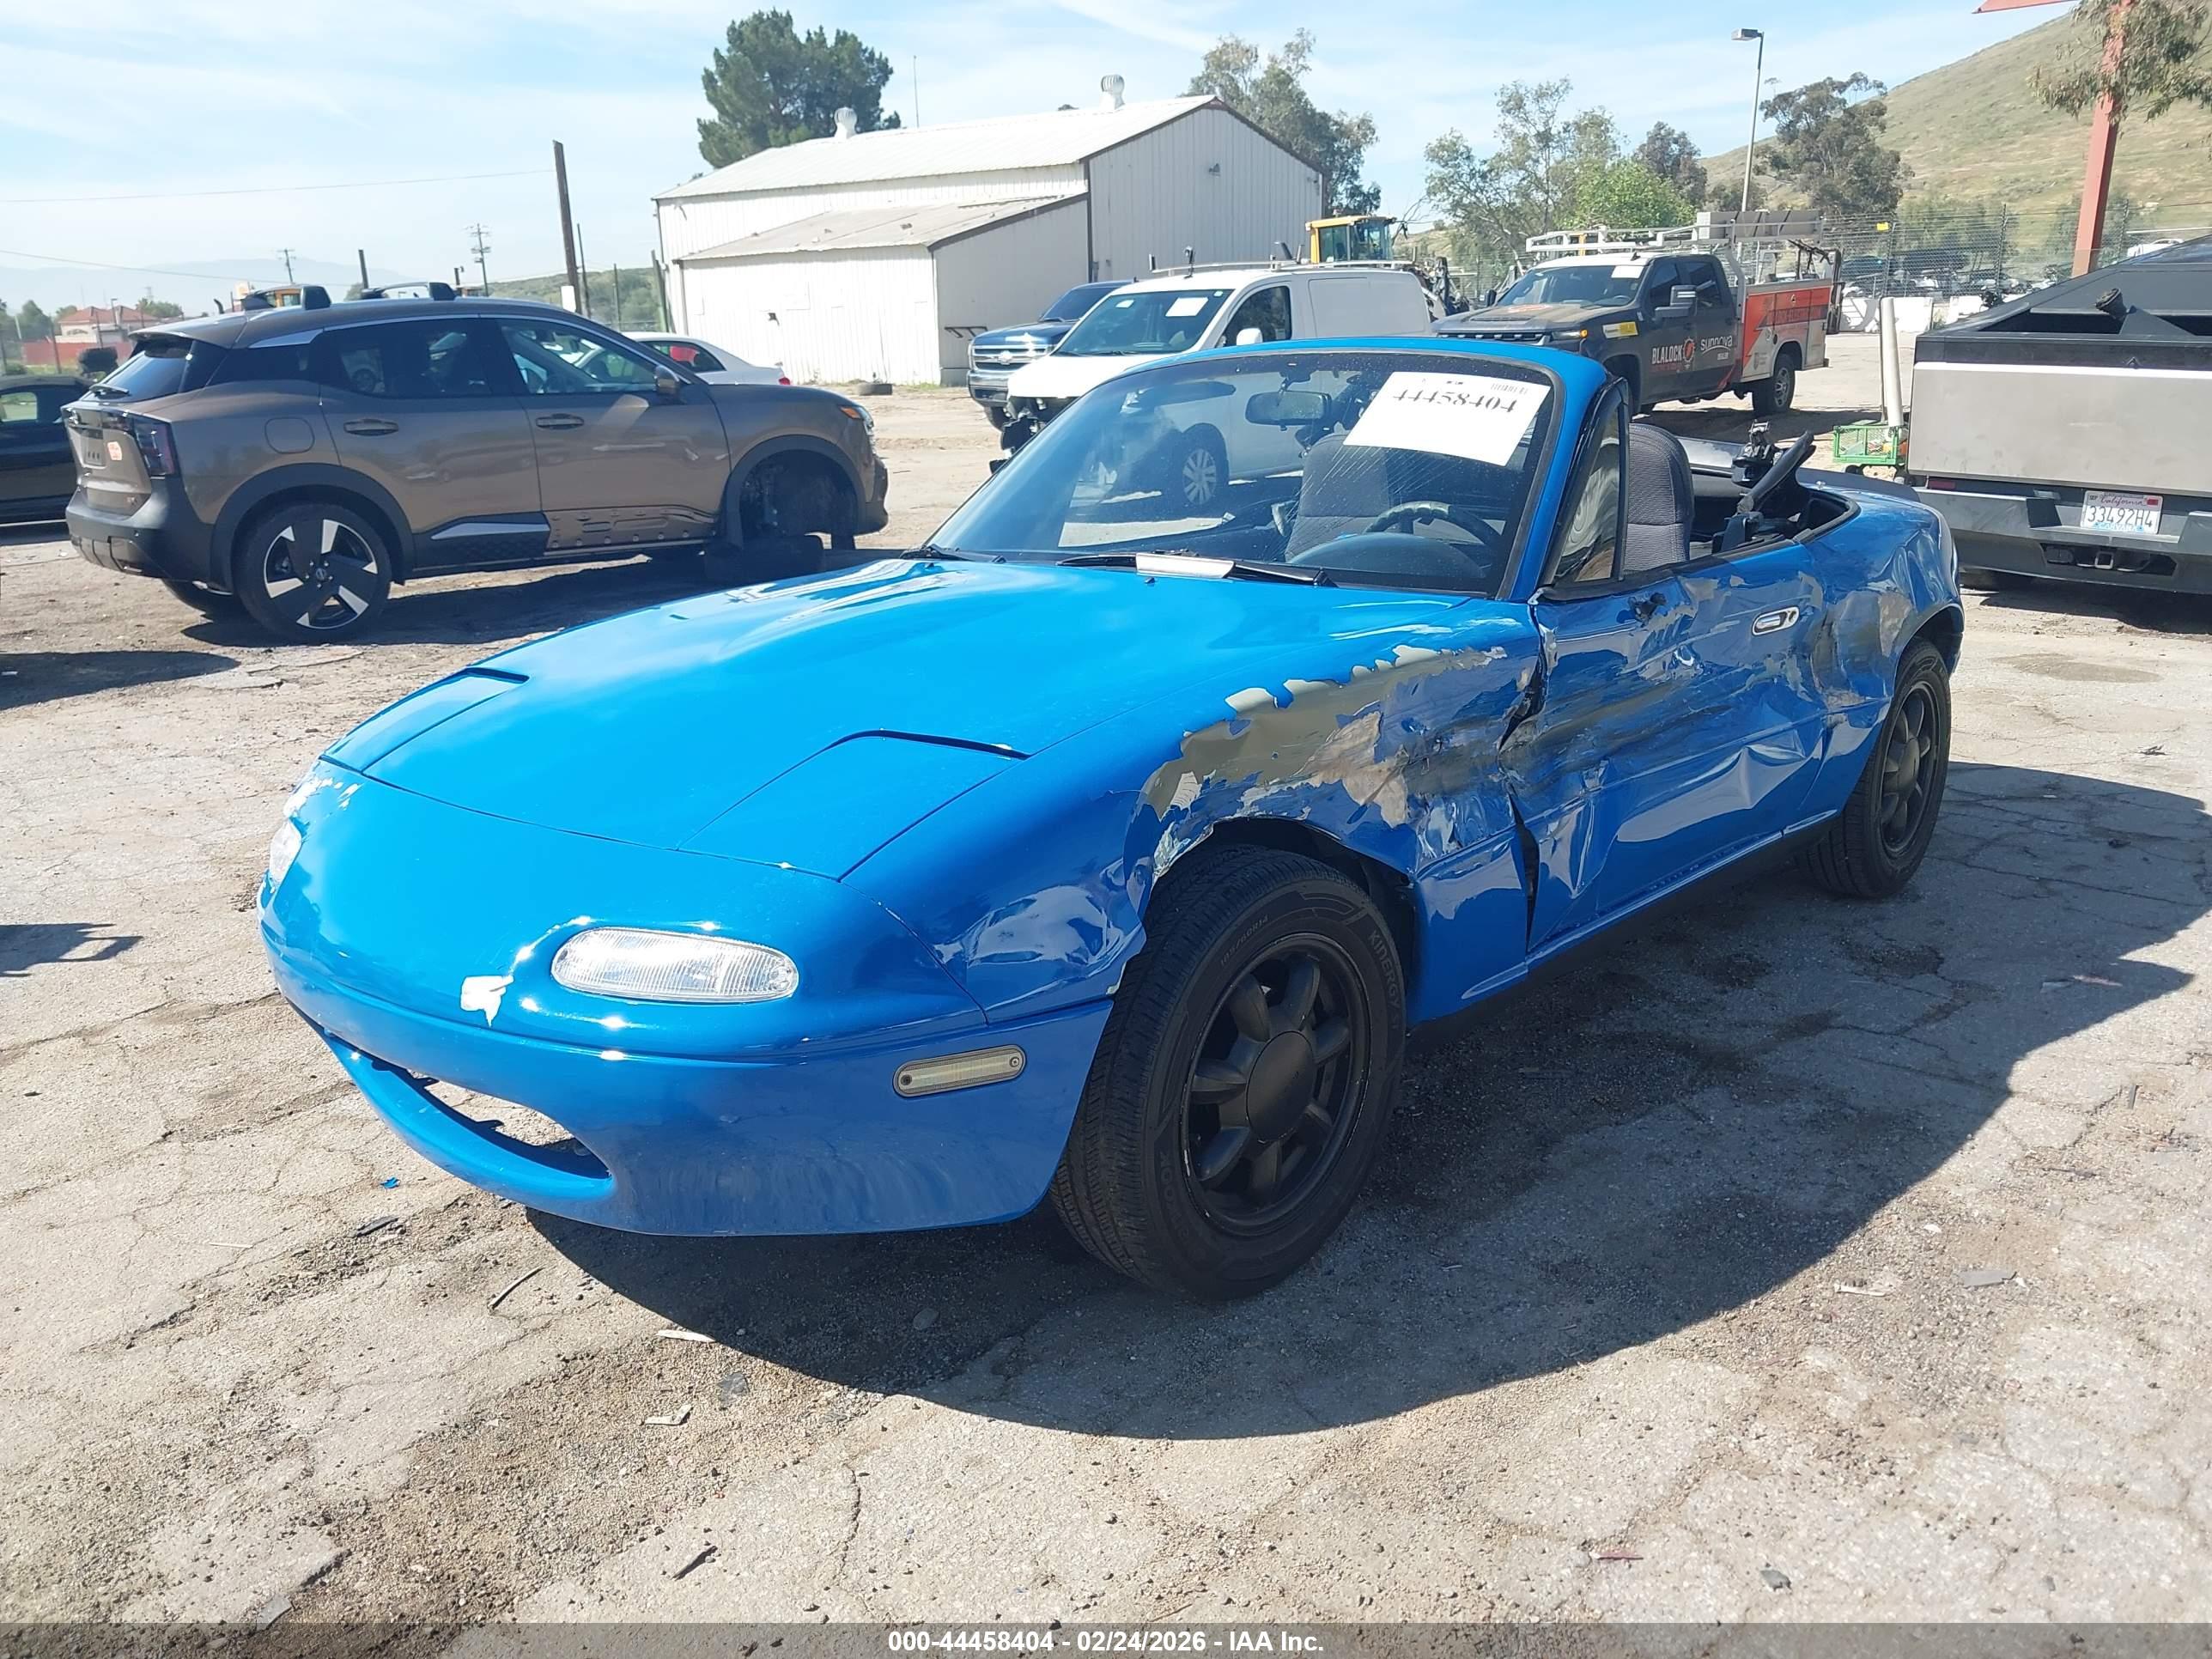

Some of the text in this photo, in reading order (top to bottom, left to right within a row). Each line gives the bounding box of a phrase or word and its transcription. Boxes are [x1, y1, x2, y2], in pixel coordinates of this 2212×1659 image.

[1651, 344, 1683, 365] BLALOCK
[1393, 389, 1517, 413] 44458404
[2100, 494, 2147, 507] California
[2087, 505, 2153, 528] 33492H4
